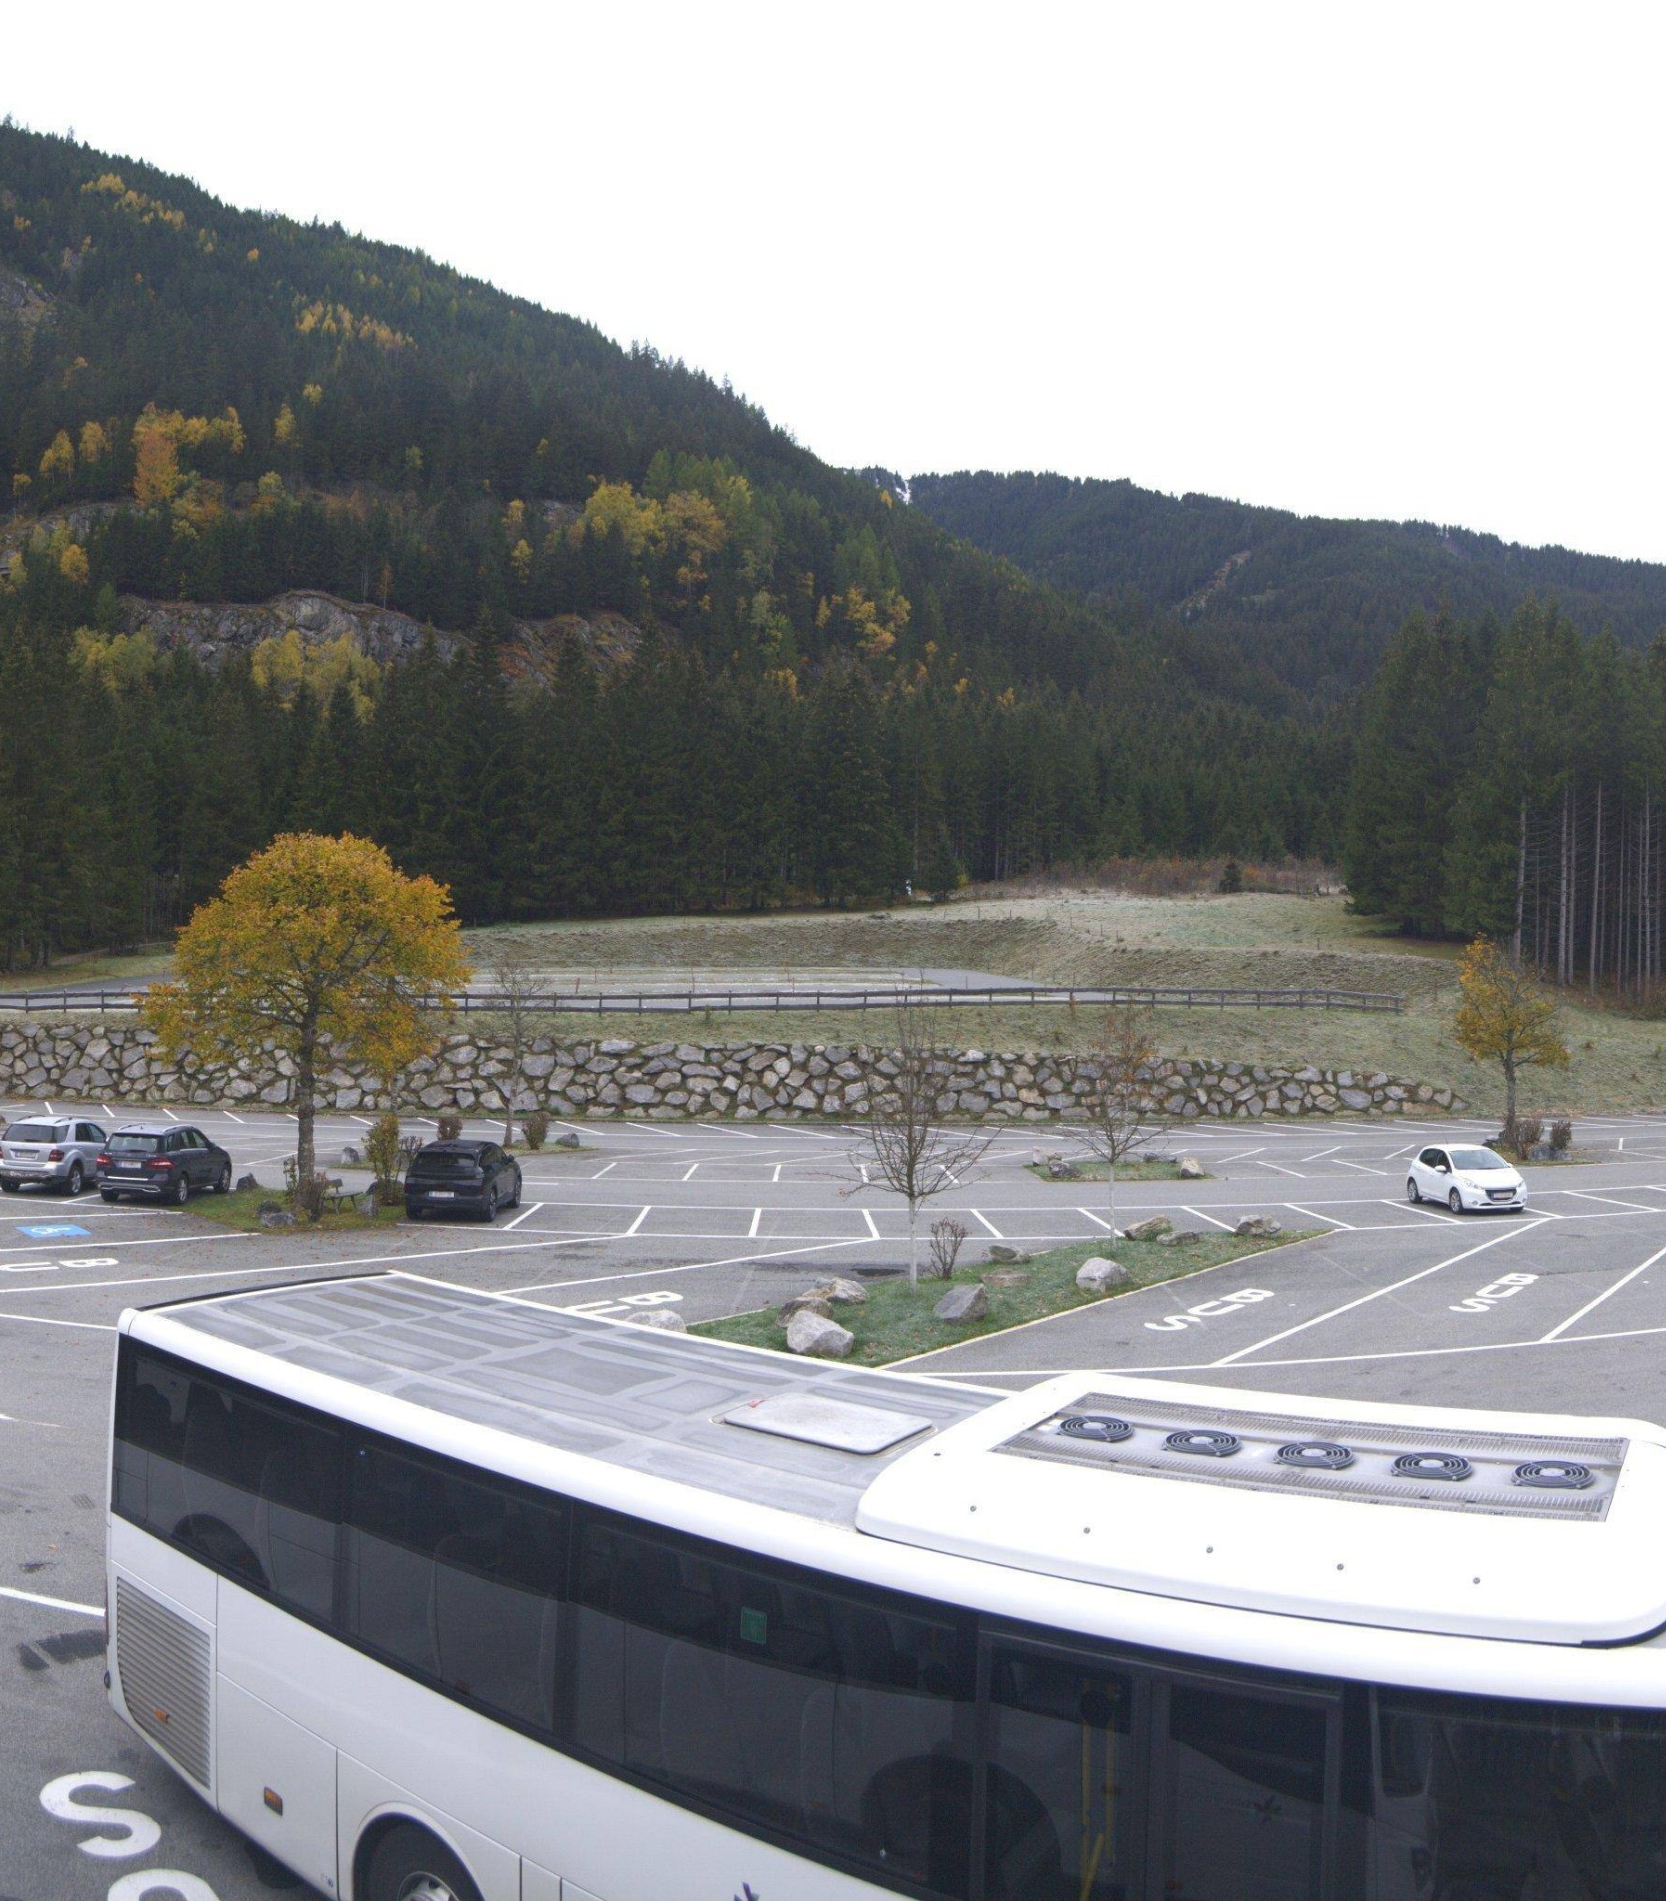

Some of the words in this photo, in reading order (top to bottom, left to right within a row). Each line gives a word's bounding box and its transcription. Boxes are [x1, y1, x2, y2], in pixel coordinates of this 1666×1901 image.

[564, 1290, 684, 1314] BU
[1144, 1288, 1275, 1332] BUS
[1448, 1272, 1540, 1313] BUS
